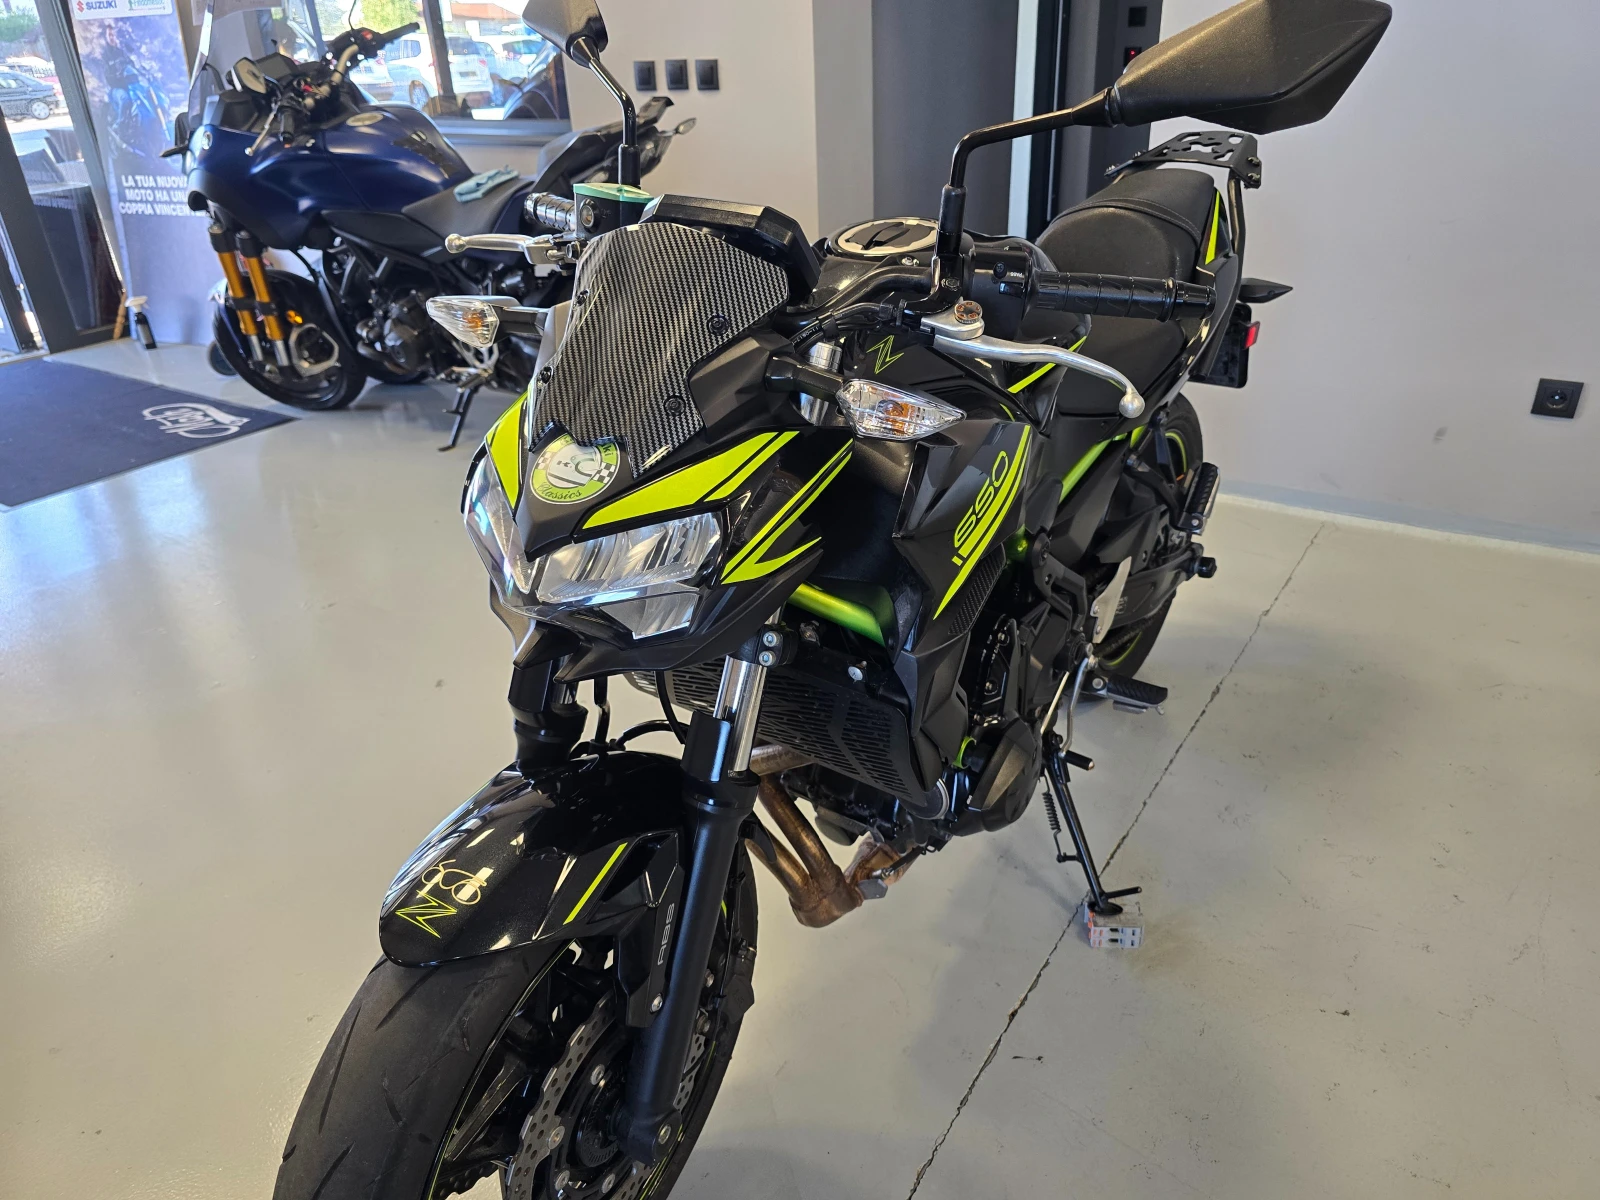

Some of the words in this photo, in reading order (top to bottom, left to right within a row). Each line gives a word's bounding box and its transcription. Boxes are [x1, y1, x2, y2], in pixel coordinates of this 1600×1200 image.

[85, 0, 117, 10] SUZUKI
[121, 174, 136, 187] LA
[135, 174, 156, 188] TUA
[125, 188, 154, 201] MOTO
[155, 189, 170, 202] HA
[118, 202, 155, 216] COPPIA
[536, 480, 582, 500] Classics
[657, 903, 675, 966] ABS
